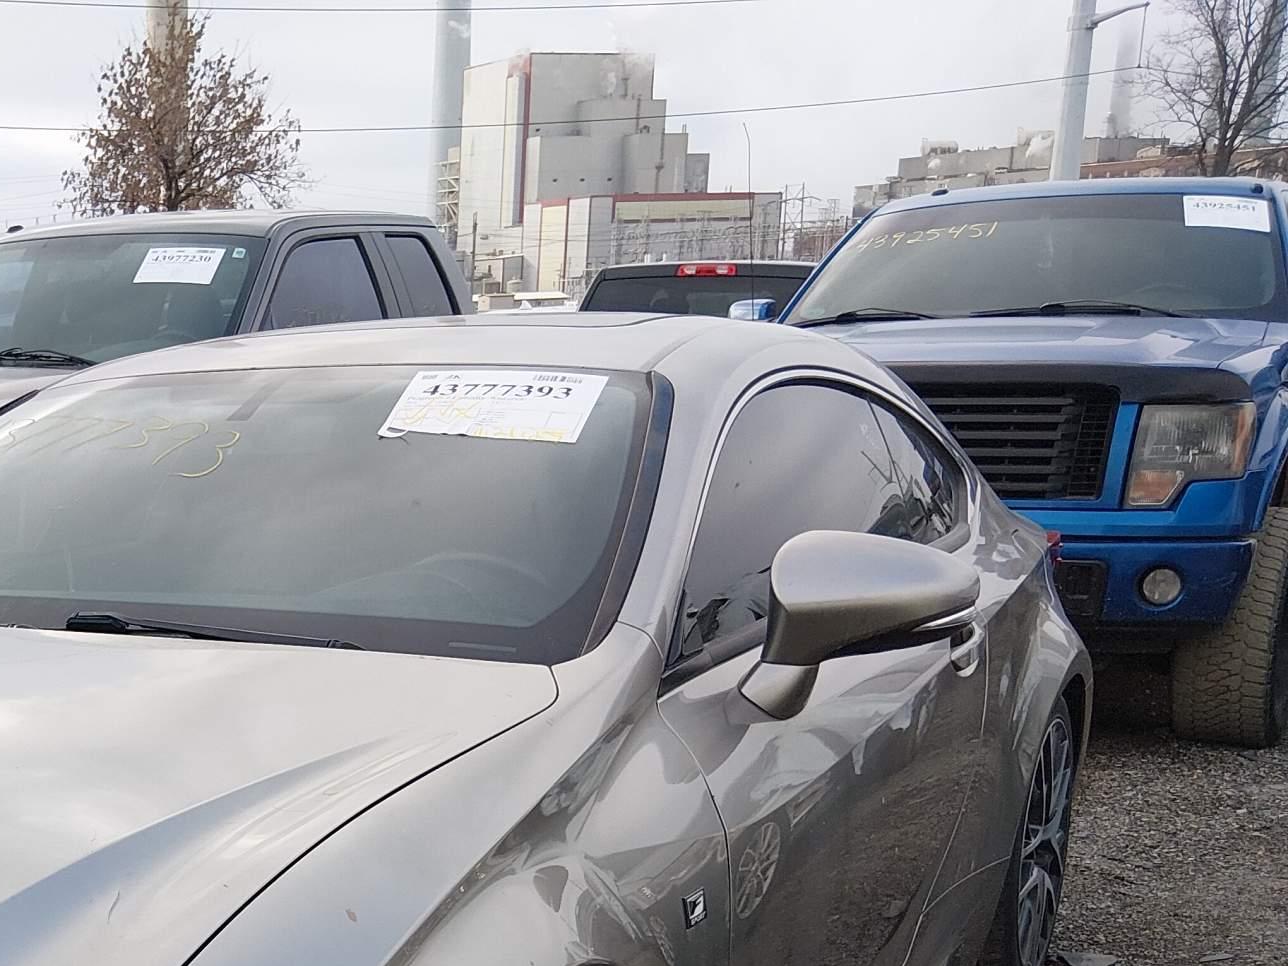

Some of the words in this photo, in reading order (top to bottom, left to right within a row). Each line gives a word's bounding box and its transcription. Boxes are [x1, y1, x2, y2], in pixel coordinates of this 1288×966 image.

[1193, 202, 1257, 212] 43925451
[856, 221, 998, 251] 43925451
[151, 255, 212, 263] 43977230
[422, 383, 573, 400] 43777393
